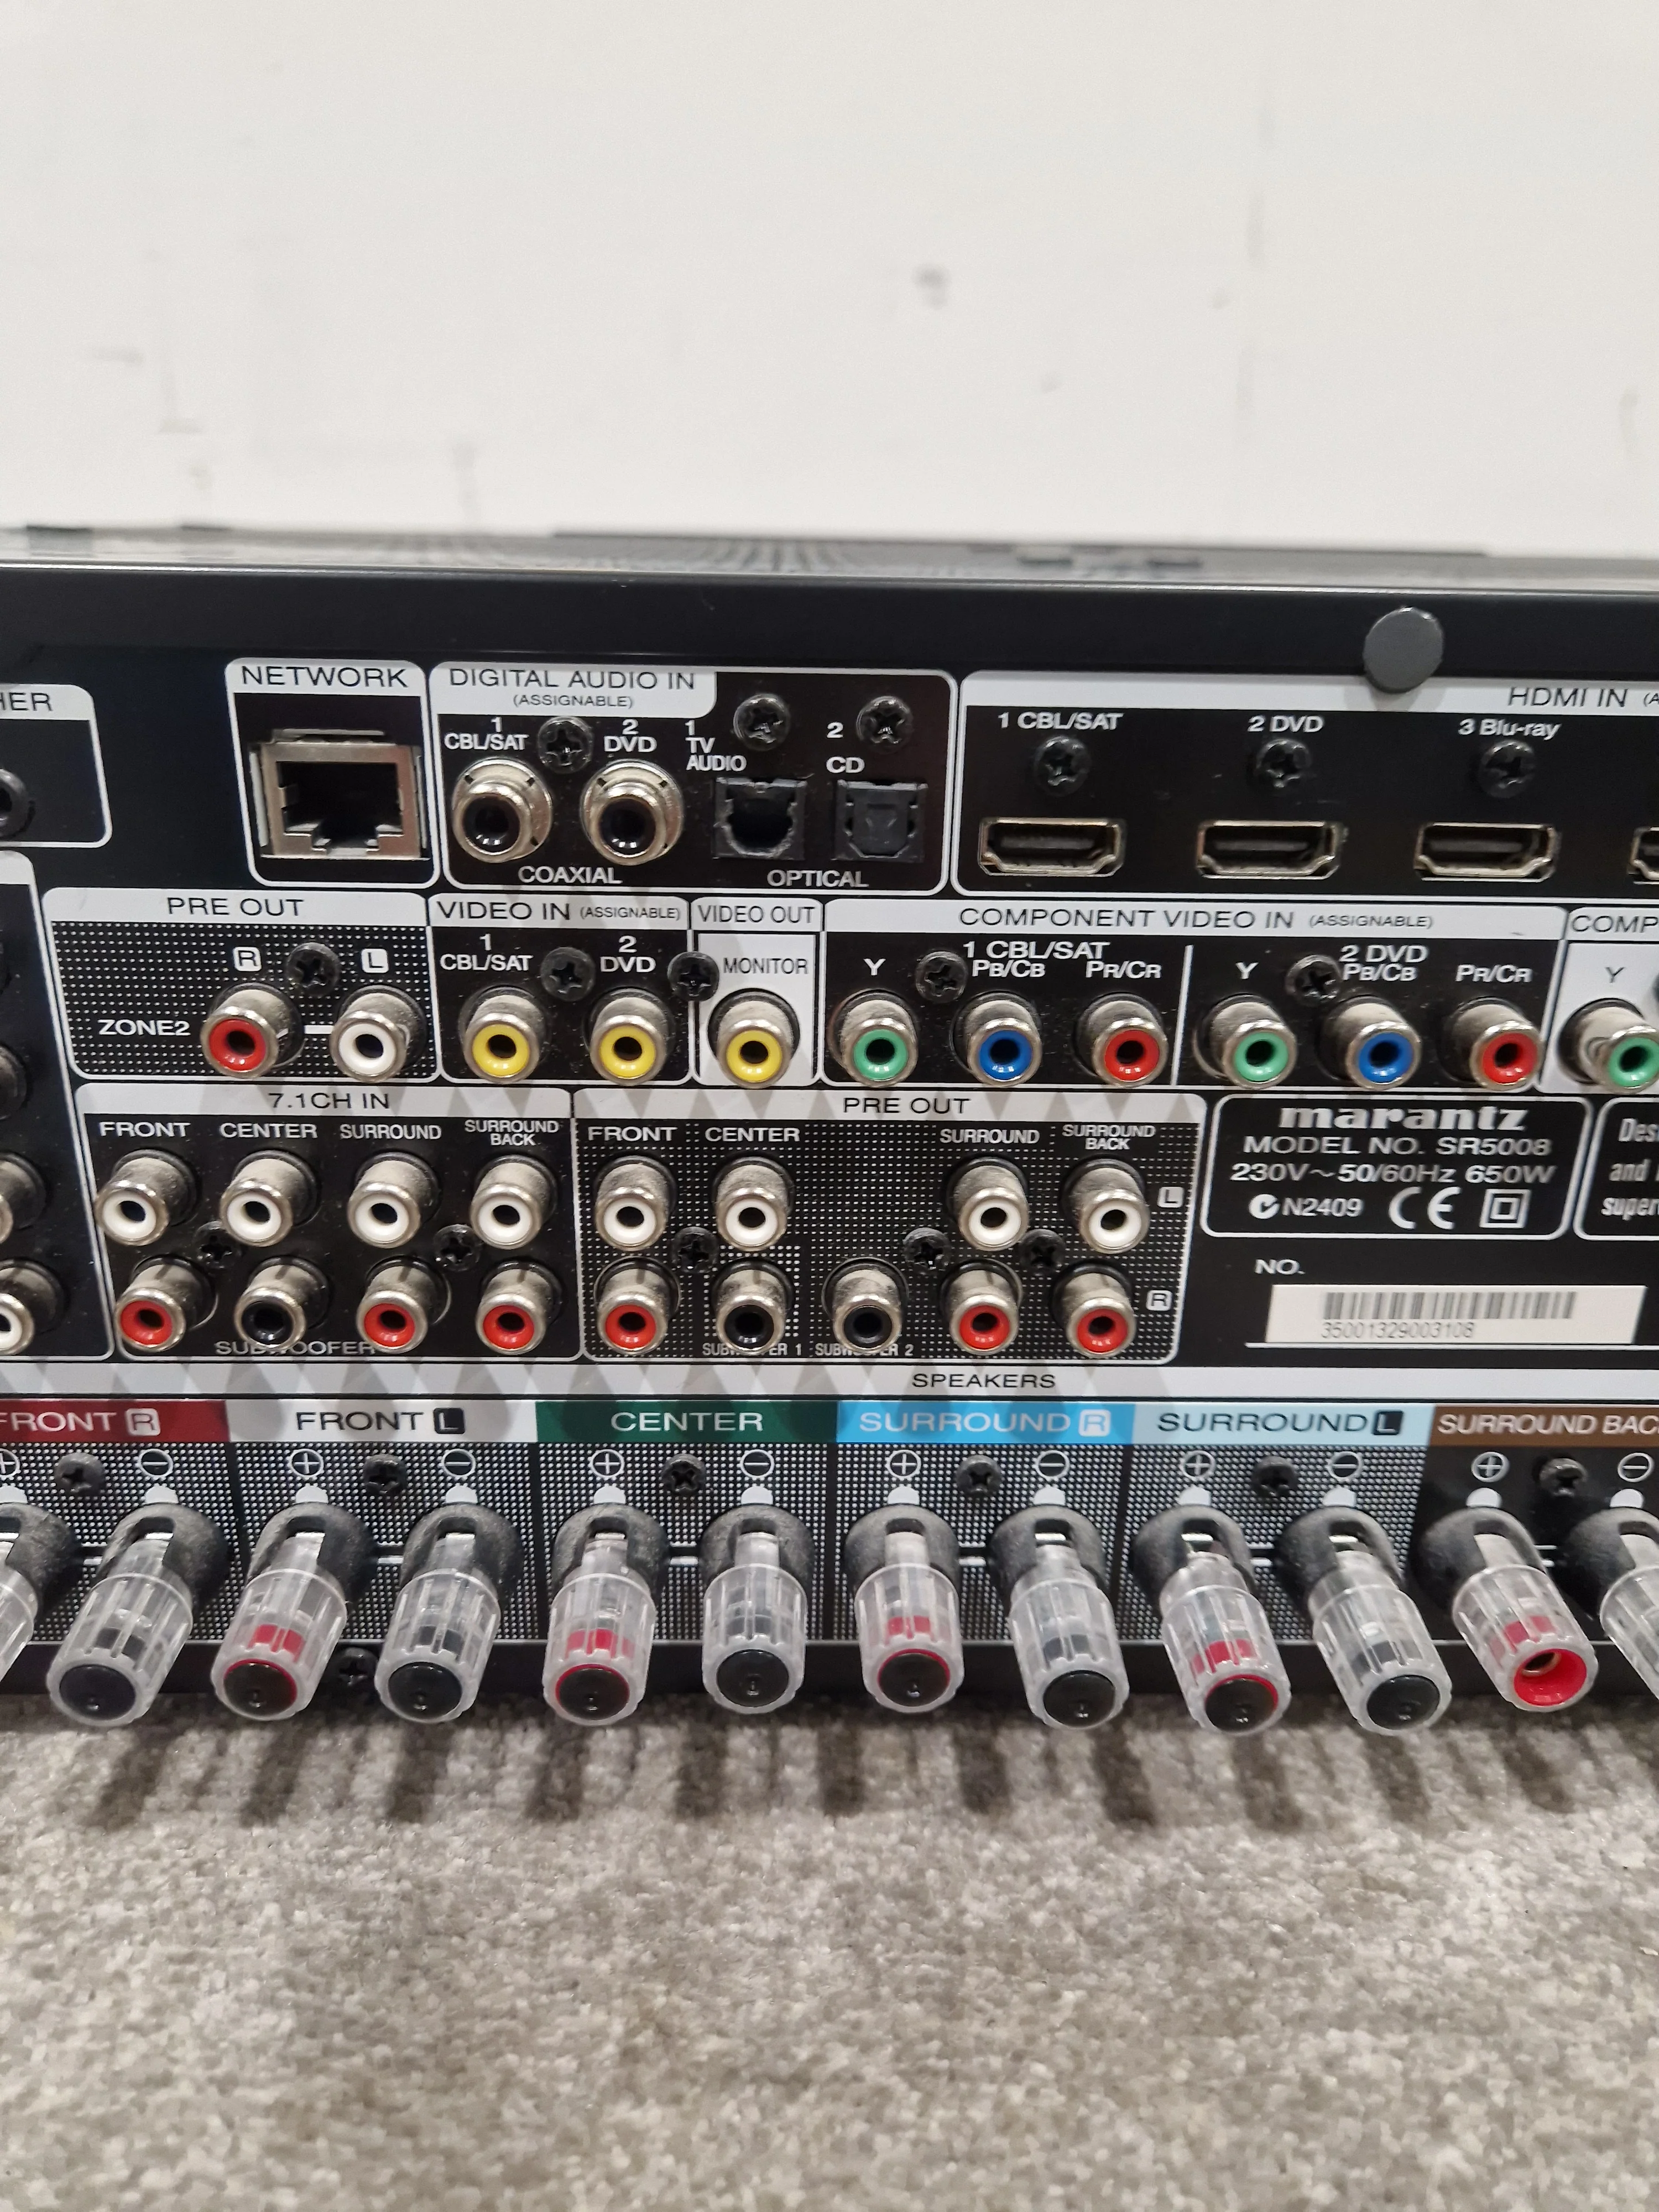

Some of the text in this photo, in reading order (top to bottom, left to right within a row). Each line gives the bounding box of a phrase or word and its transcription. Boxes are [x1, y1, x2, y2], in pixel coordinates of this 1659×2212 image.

[243, 666, 409, 688] NETWORK
[450, 668, 695, 690] DIGITAL AUDIO IN
[513, 693, 634, 708] (ASSIGNABLE)
[1508, 687, 1589, 707] HDMI
[1597, 688, 1629, 708] IN
[491, 717, 502, 732] 1
[622, 719, 639, 735] 2
[685, 721, 696, 736] 1
[998, 711, 1124, 731] 1 CBL/SAT
[1248, 716, 1326, 733] 2 DVD
[827, 722, 843, 738] 2
[1458, 720, 1562, 740] 3 Blu-ray
[444, 733, 529, 752] CBL/SAT
[604, 736, 657, 753] DVD
[686, 737, 716, 753] TV
[686, 755, 747, 772] AUDIO
[827, 757, 865, 774] CD
[518, 867, 623, 884] COAXIAL
[767, 870, 869, 888] OPTICAL
[167, 897, 305, 917] PRE OUT
[437, 901, 681, 921] VIDEO IN (ASSIGNABLE)
[697, 906, 816, 924] VIDEO OUT
[959, 908, 1433, 930] COMPONENT VIDEO IN (ASSIGNABLE)
[479, 935, 492, 951] 1
[618, 936, 637, 953] 2
[963, 941, 1110, 959] 1 CBL/SAT
[1339, 945, 1428, 963] 2 DVD
[440, 954, 534, 972] CBL/SAT
[600, 956, 656, 973] DVD
[723, 957, 809, 974] MONITOR
[864, 958, 886, 976] Y
[1235, 962, 1259, 980] Y
[1605, 967, 1625, 983] Y
[98, 1019, 191, 1037] ZONE2
[362, 1093, 391, 1110] IN
[843, 1097, 971, 1114] PRE OUT
[465, 1119, 559, 1135] SURROUND
[1279, 1106, 1529, 1131] marantz
[98, 1121, 191, 1139] FRONT
[219, 1122, 318, 1139] CENTER
[340, 1123, 442, 1140] SURROUND
[588, 1126, 678, 1142] FRONT
[705, 1127, 800, 1142] CENTER
[940, 1129, 1040, 1145] SURROUND
[1062, 1124, 1156, 1139] SURROUND
[491, 1133, 535, 1147] BACK
[1085, 1137, 1130, 1151] BACK
[1243, 1135, 1552, 1156] MODEL NO. SR5008
[1464, 1165, 1558, 1184] 650W
[1608, 1159, 1651, 1181] and
[1282, 1198, 1364, 1217] N2409
[1255, 1259, 1306, 1275] NO.
[215, 1341, 375, 1354] SUBOOFER
[795, 1343, 802, 1356] 1
[904, 1344, 914, 1356] 2
[912, 1373, 1056, 1389] SPEAKERS
[296, 1411, 424, 1431] FRONT
[611, 1412, 764, 1432] CENTER
[859, 1412, 1071, 1433] SURROUND
[1157, 1412, 1367, 1433] SURROUND
[1438, 1413, 1659, 1435] SURROUND BAC
